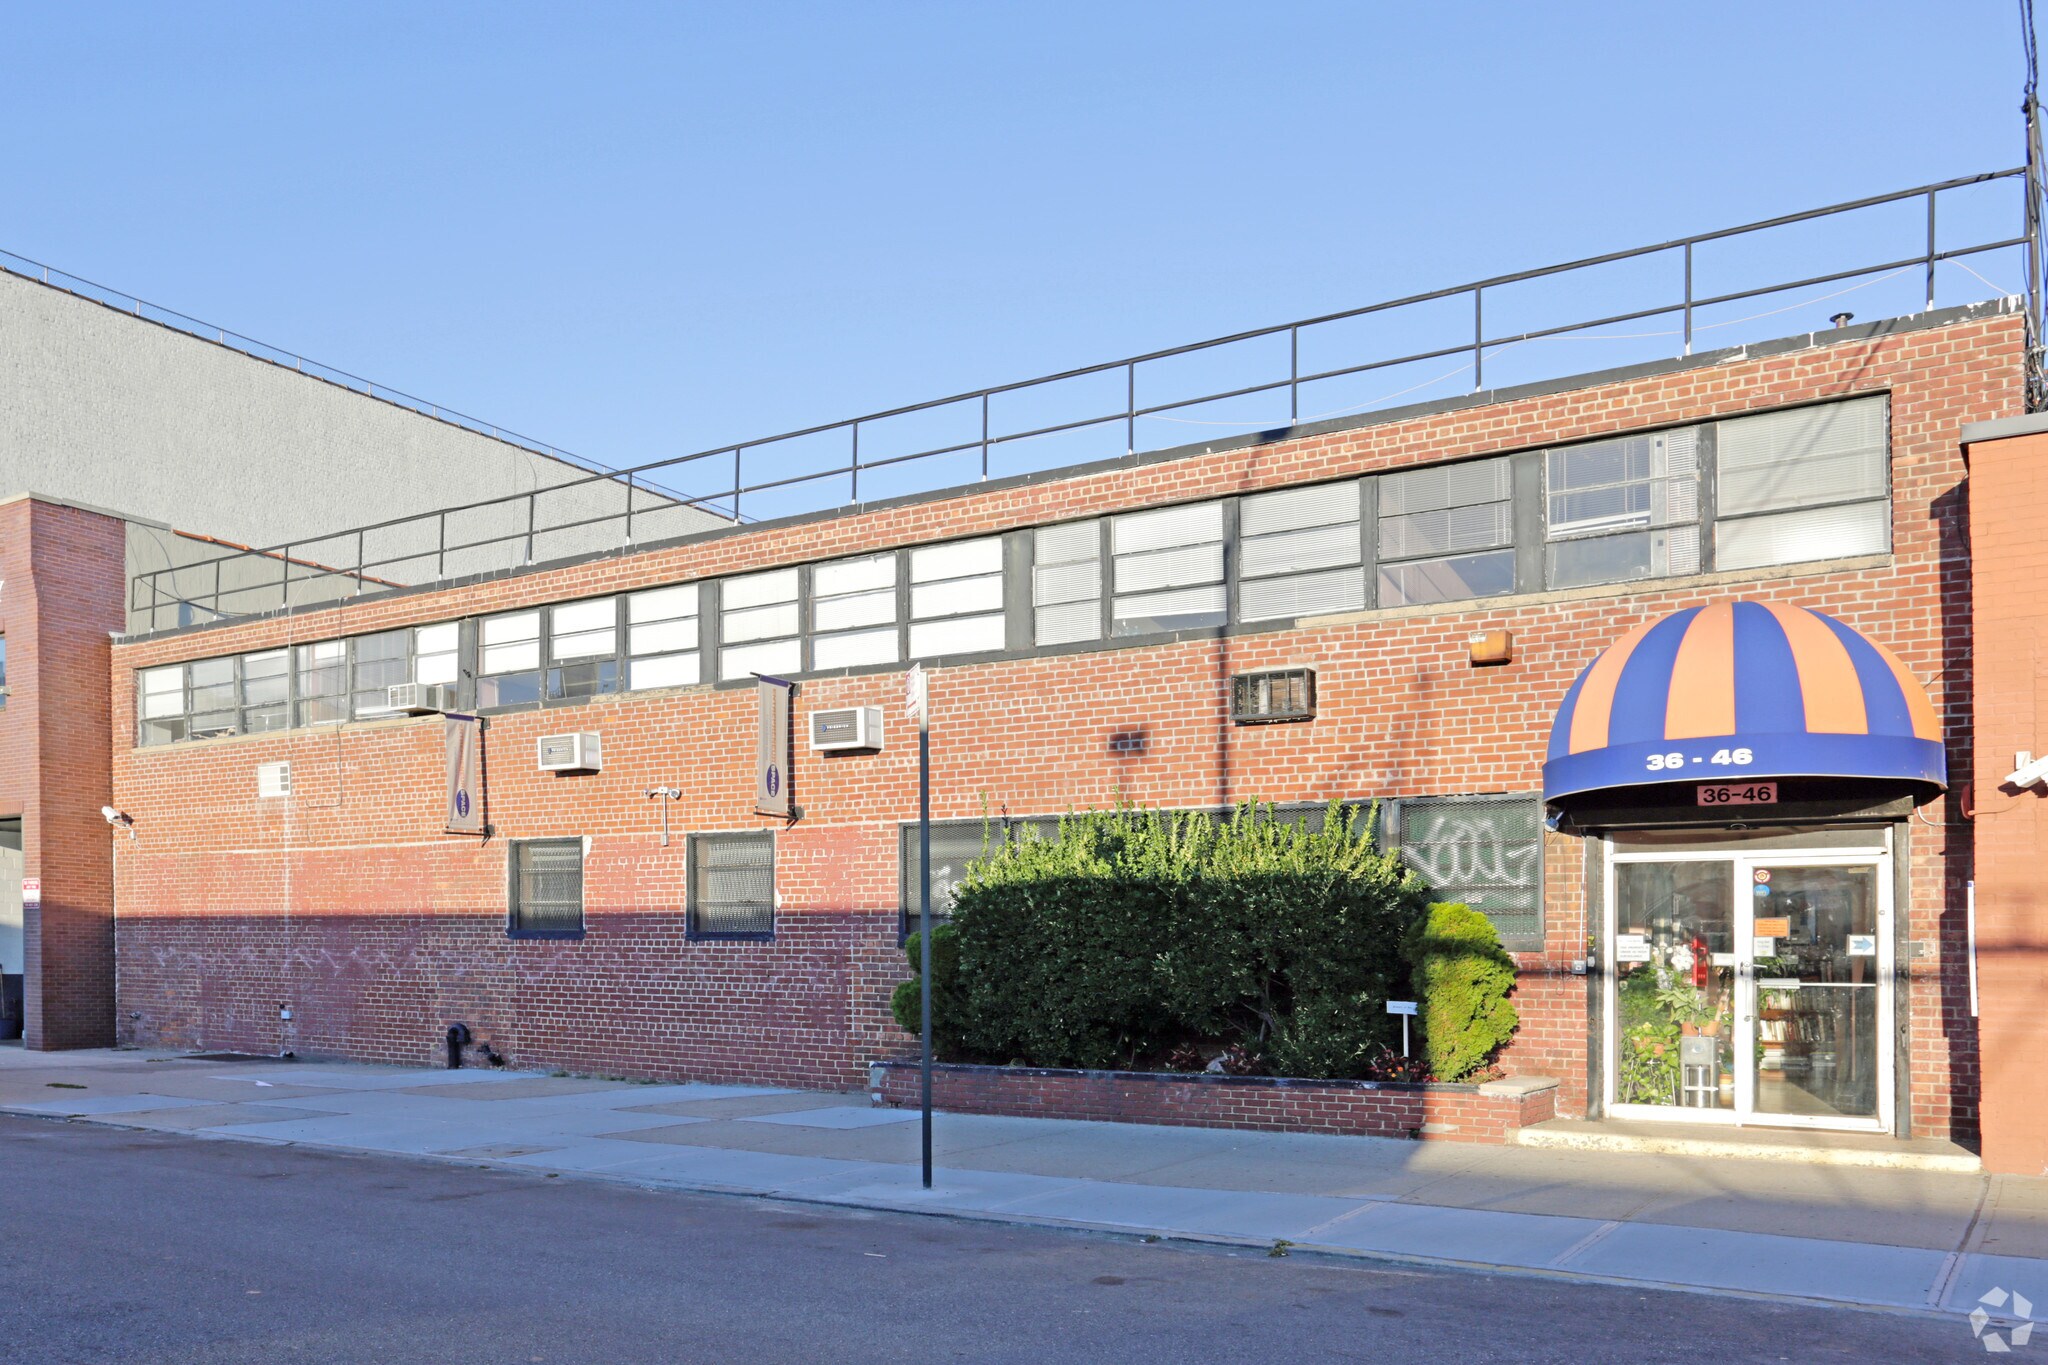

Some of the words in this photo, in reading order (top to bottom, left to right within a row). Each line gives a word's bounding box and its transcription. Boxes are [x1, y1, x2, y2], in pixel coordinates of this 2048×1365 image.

[1646, 752, 1684, 771] 36
[1711, 748, 1753, 765] 46
[1703, 786, 1772, 803] 36-46
